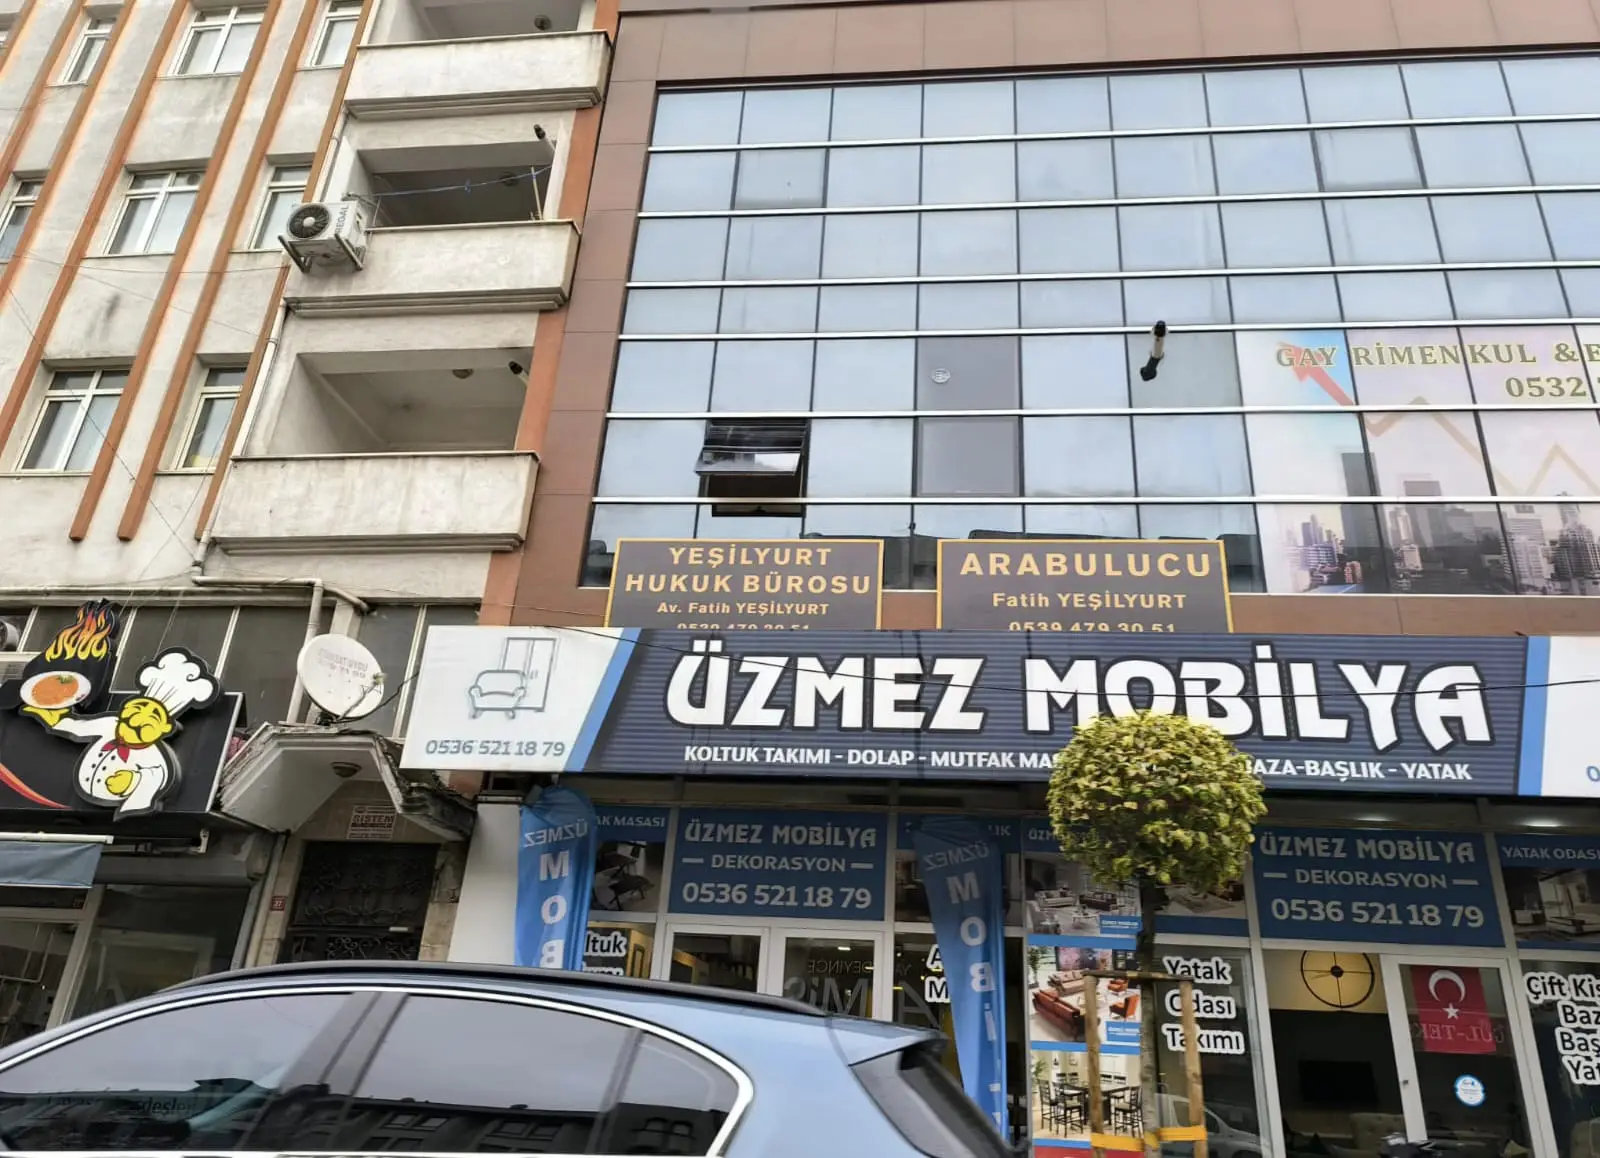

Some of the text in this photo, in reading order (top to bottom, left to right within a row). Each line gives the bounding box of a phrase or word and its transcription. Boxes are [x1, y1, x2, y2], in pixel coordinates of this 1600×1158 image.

[1554, 343, 1580, 362] &
[1504, 376, 1588, 398] 0532
[670, 544, 832, 568] YEŞİLYURT
[960, 552, 1211, 577] ARABULUCU
[625, 570, 871, 594] HUKUK BÜROSU
[657, 601, 829, 616] Av. Fatih YEŞİLYURT
[992, 590, 1187, 611] Fatih YEŞİLYURT
[669, 638, 1493, 752] ÜZMEZ MOBİLYA
[425, 740, 565, 757] 0536 521 18 79
[684, 745, 760, 762] KOLTUK
[764, 747, 831, 764] TAKIMI
[848, 749, 915, 766] DOLAP
[931, 751, 1015, 768] MUTFAK
[1401, 762, 1472, 780] YATAK
[613, 815, 666, 828] MASASI
[685, 818, 876, 848] ÜZMEZ MOBİLYA
[1259, 831, 1475, 864] ÜZMEZ MOBİLYA
[1501, 847, 1551, 859] YATAK
[711, 854, 846, 872] DEKORASYON
[1295, 868, 1448, 889] DEKORASYON
[682, 882, 872, 909] 0536 521 18 79
[1271, 898, 1485, 928] 0536 521 18 79
[1166, 959, 1229, 981] Yatak
[1526, 975, 1567, 1000] Çift
